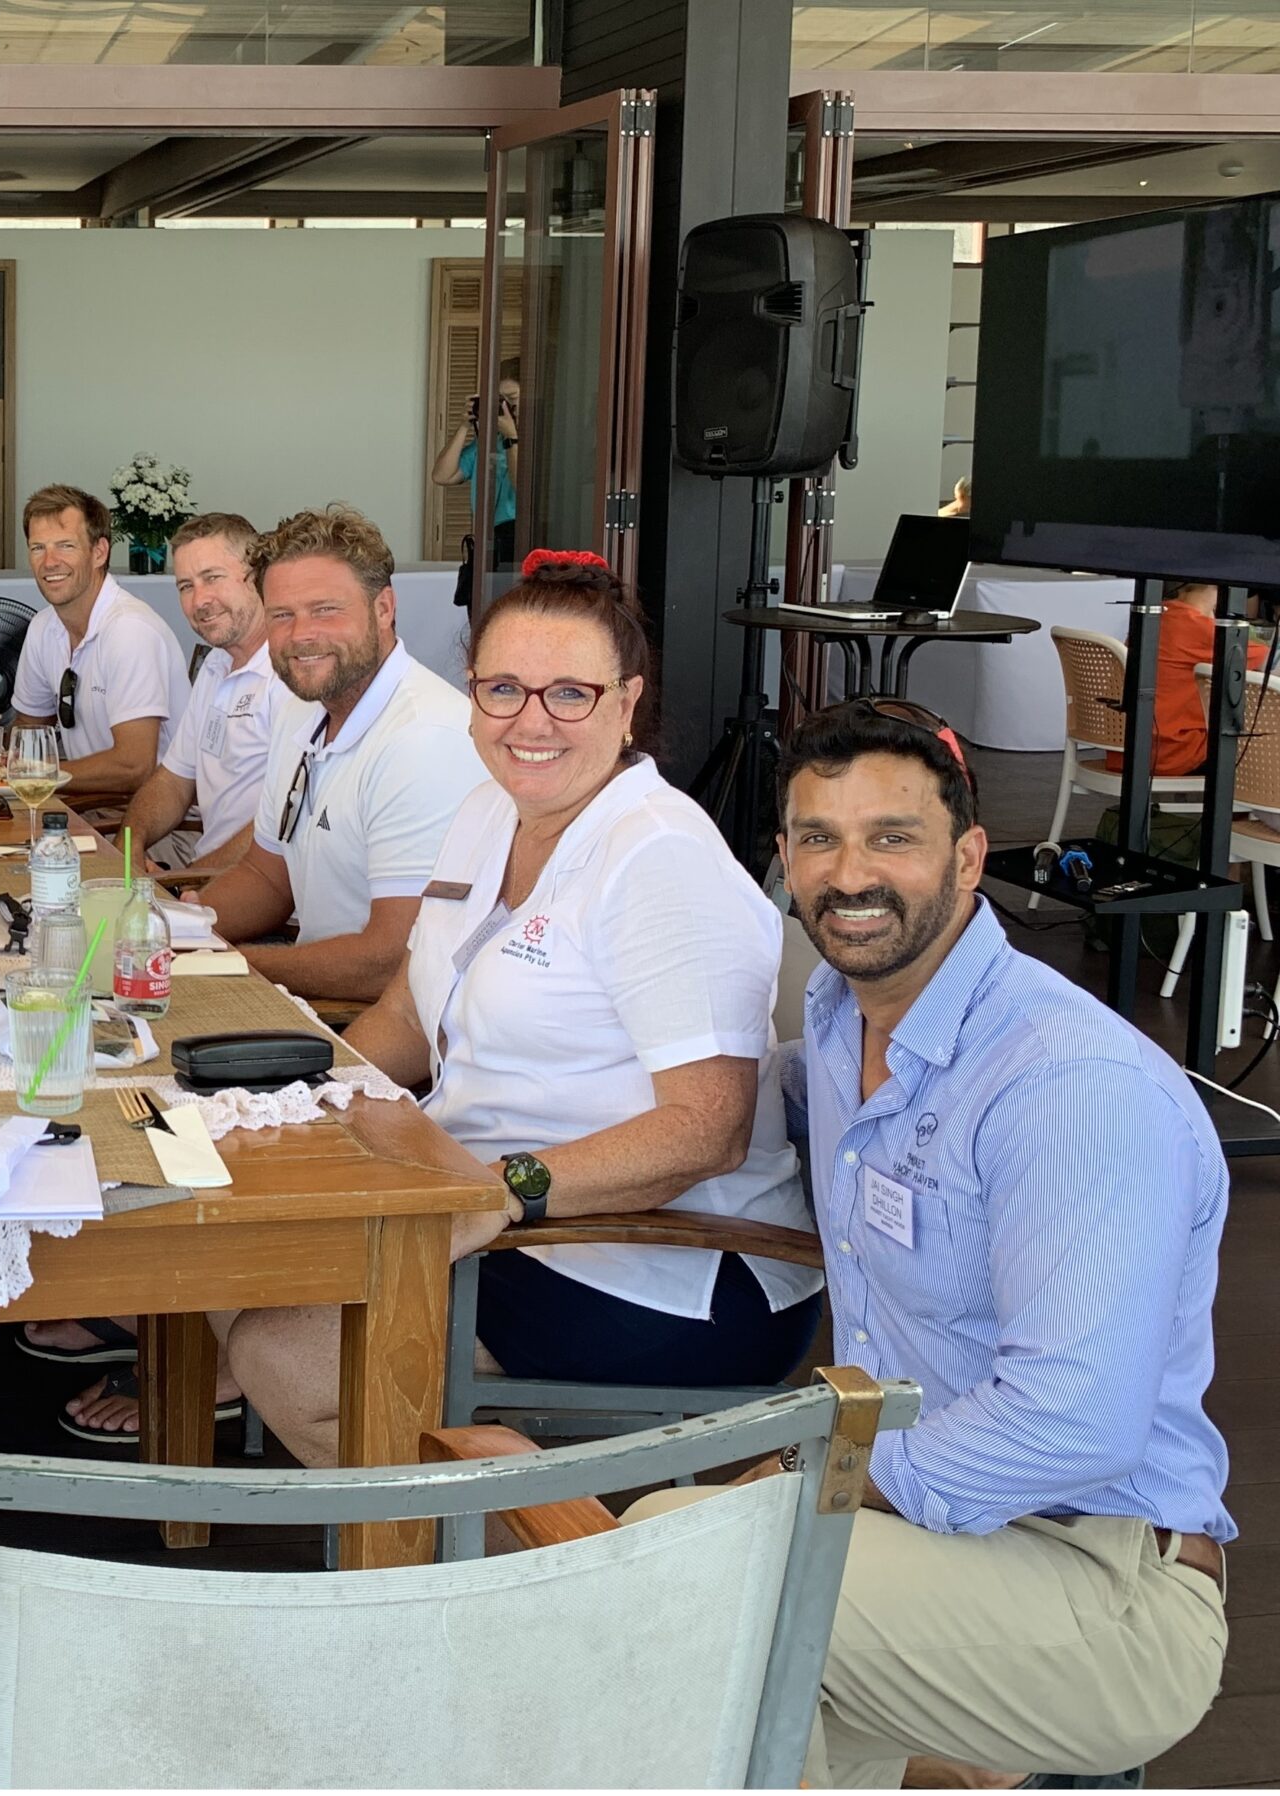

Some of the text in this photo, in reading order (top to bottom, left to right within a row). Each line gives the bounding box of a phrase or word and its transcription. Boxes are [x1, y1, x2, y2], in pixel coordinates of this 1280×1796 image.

[871, 1178, 904, 1205] JAI SINGH
[912, 1172, 939, 1191] HAVEN
[872, 1193, 902, 1220] DHILLON
